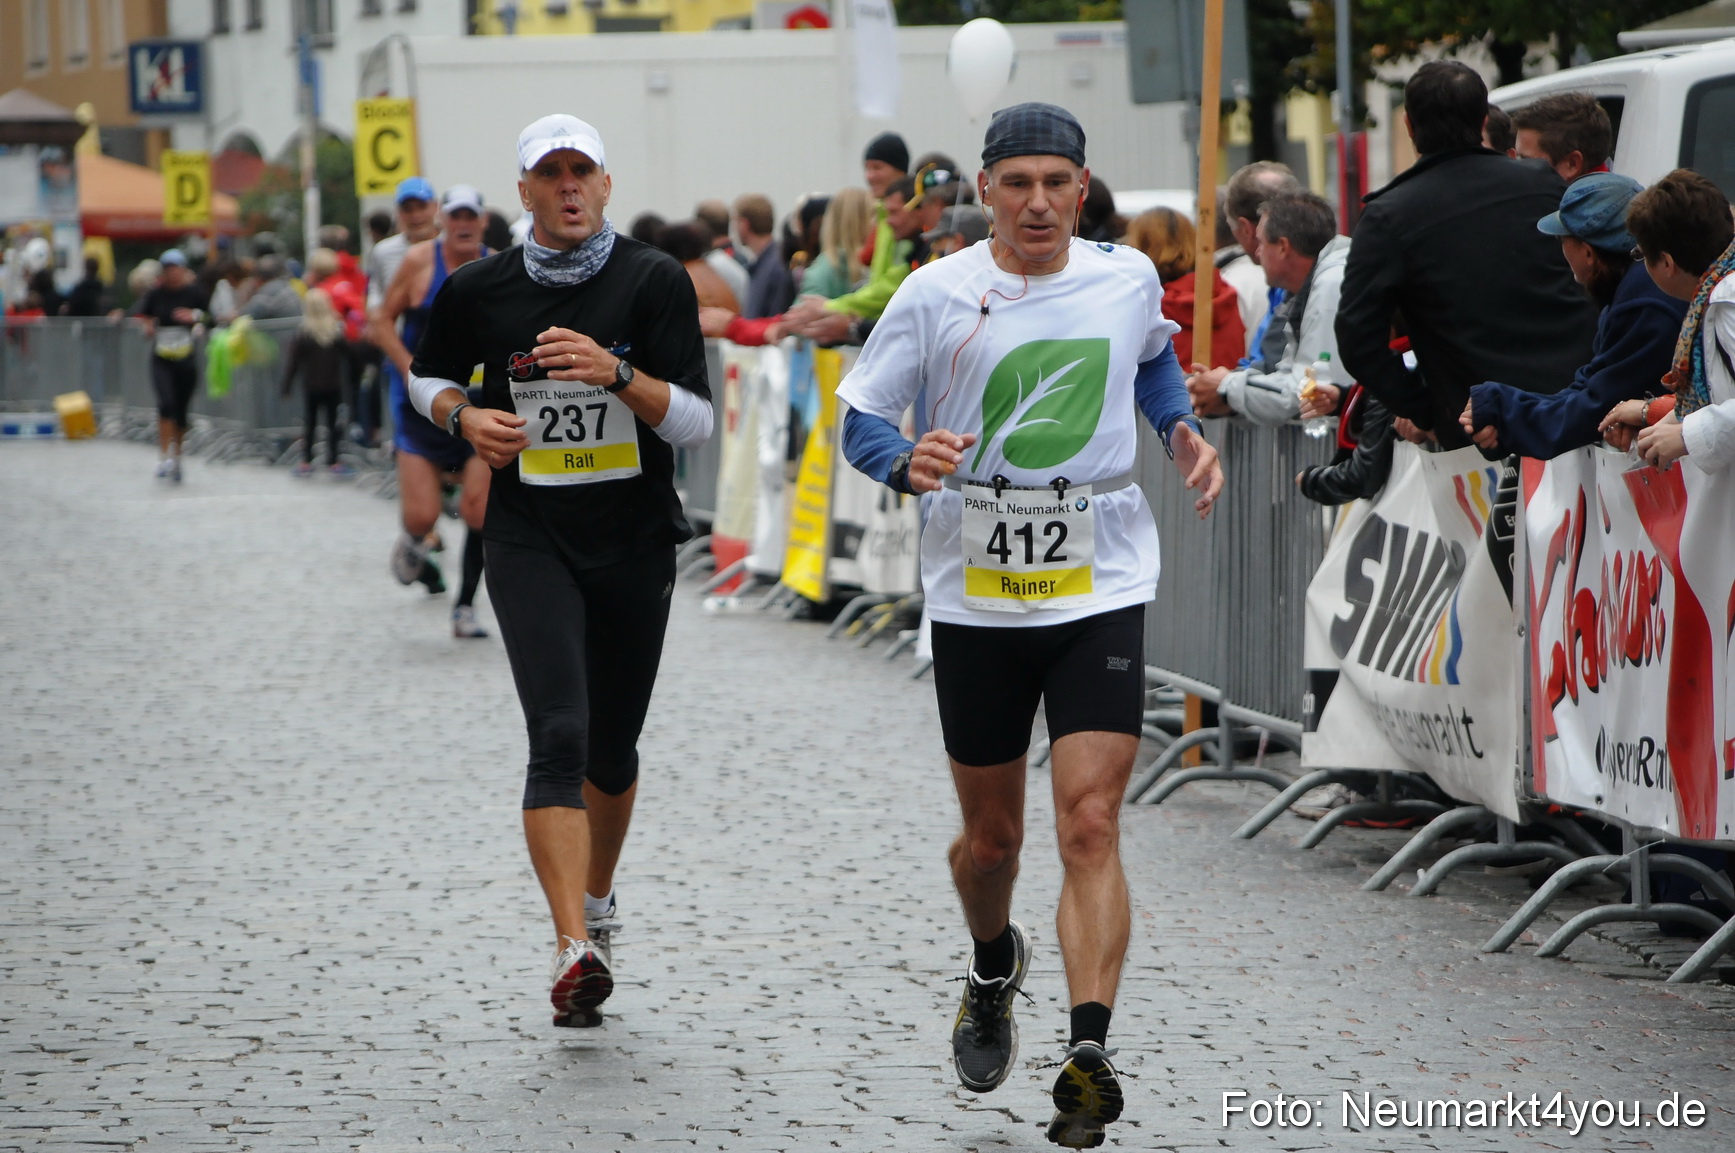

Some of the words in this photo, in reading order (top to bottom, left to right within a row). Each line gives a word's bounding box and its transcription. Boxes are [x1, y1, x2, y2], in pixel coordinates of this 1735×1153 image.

[371, 127, 403, 172] C
[176, 172, 202, 208] D
[514, 389, 552, 401] PARTL
[553, 387, 609, 400] Neumarkt
[538, 402, 608, 443] 237
[564, 453, 595, 469] Ralf
[965, 498, 1004, 514] PARTL
[1007, 503, 1071, 515] Neumarkt
[986, 520, 1068, 565] 412
[967, 557, 974, 566] A
[1001, 576, 1056, 596] Rainer
